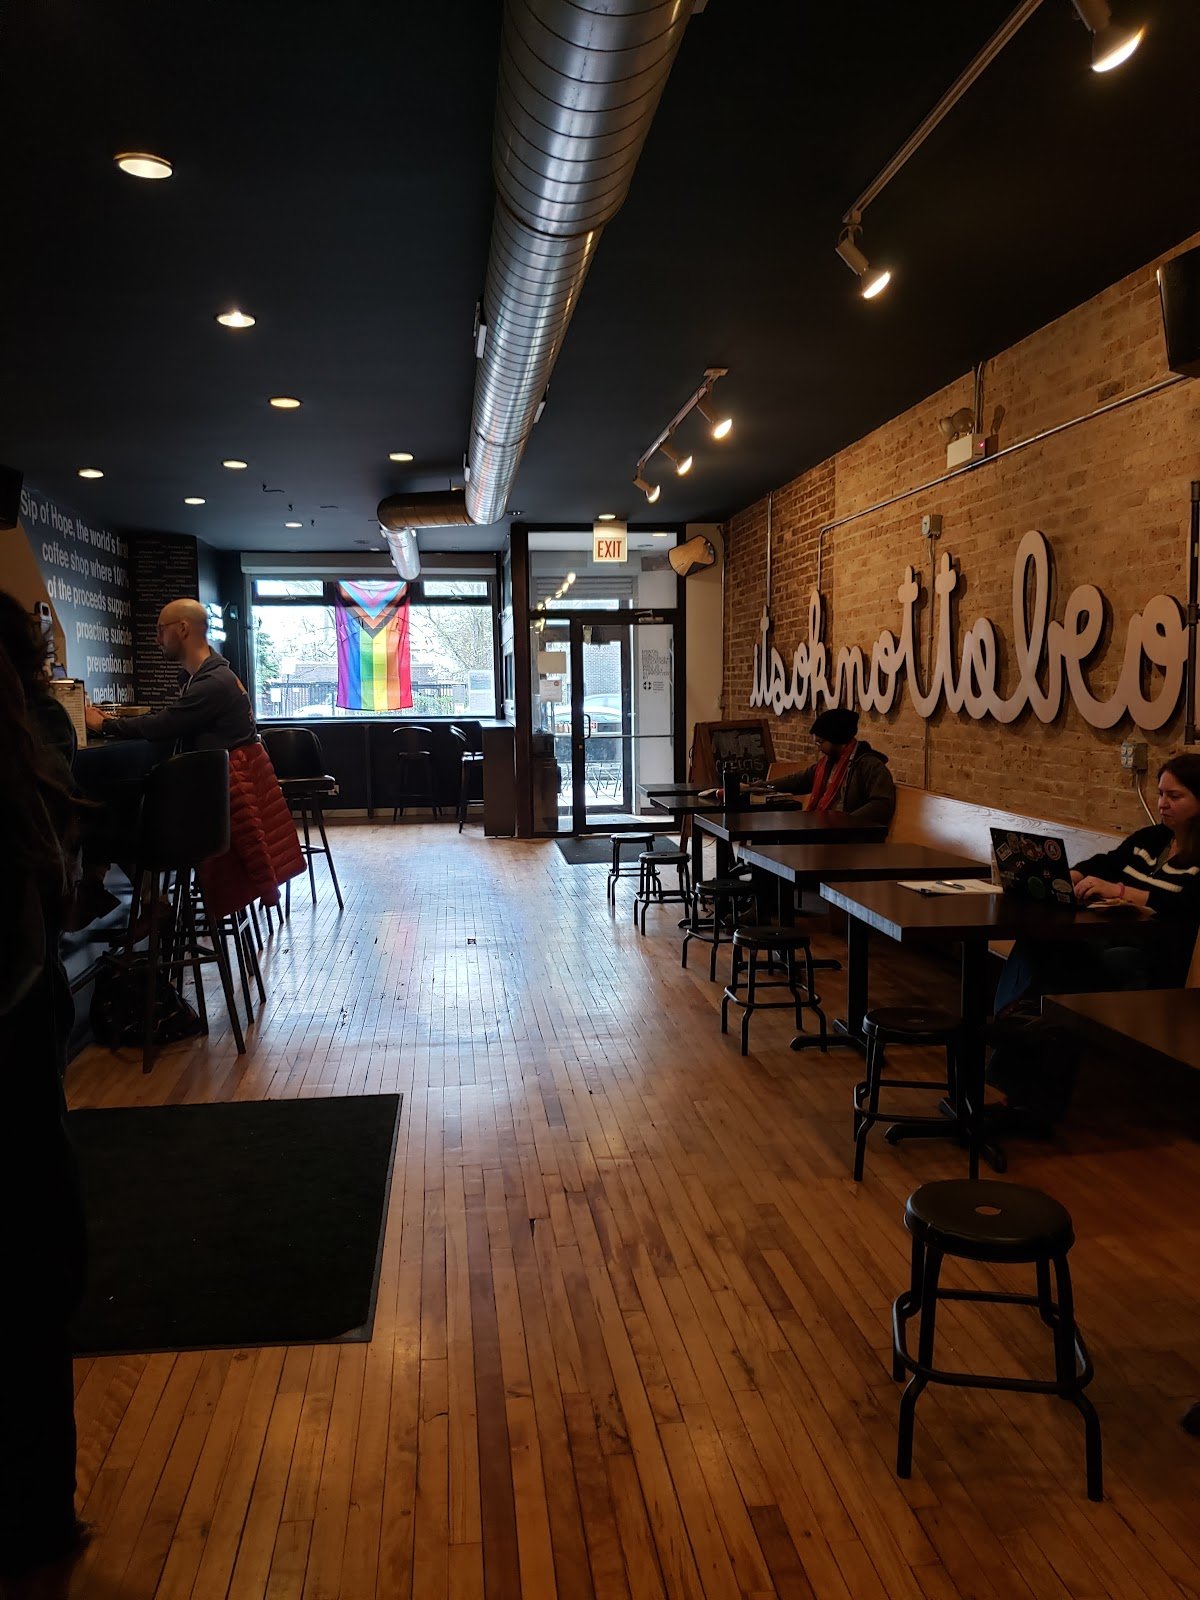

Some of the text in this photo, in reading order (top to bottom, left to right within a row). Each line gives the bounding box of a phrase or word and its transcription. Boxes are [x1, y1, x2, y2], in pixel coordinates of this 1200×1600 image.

[20, 489, 38, 525] Sip
[40, 502, 50, 525] of
[51, 504, 75, 541] Hope,
[76, 520, 89, 543] the
[90, 529, 116, 554] world's
[597, 540, 622, 558] EXIT
[42, 542, 69, 569] coffee
[70, 550, 89, 580] shop
[90, 558, 113, 583] where
[47, 576, 131, 620] of the proceeds support
[76, 621, 133, 647] proactive suicide
[86, 653, 134, 678] prevention and
[93, 682, 135, 703] mental health
